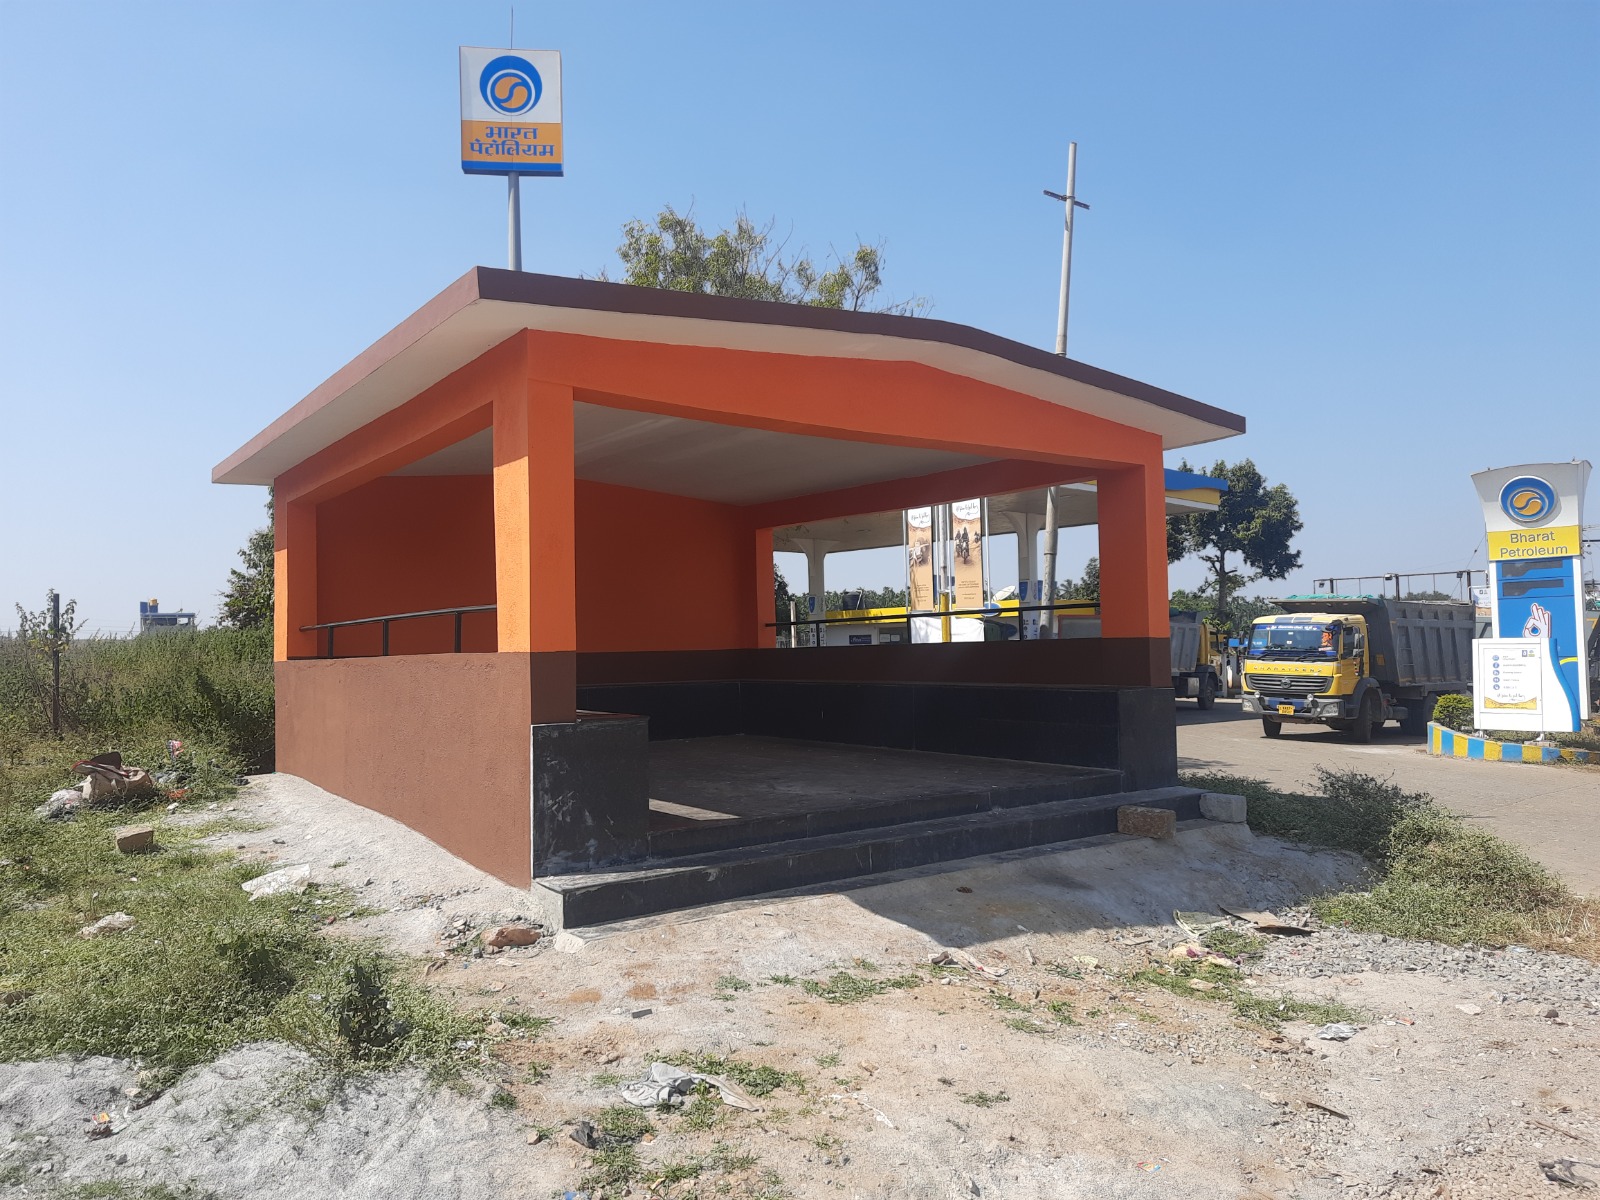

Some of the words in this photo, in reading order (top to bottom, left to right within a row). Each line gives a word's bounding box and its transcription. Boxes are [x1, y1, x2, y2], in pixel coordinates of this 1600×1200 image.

[486, 126, 538, 139] भारत
[470, 138, 555, 157] पेट्रोलियम
[1510, 531, 1555, 544] Bharat
[1500, 545, 1568, 558] Petroleum
